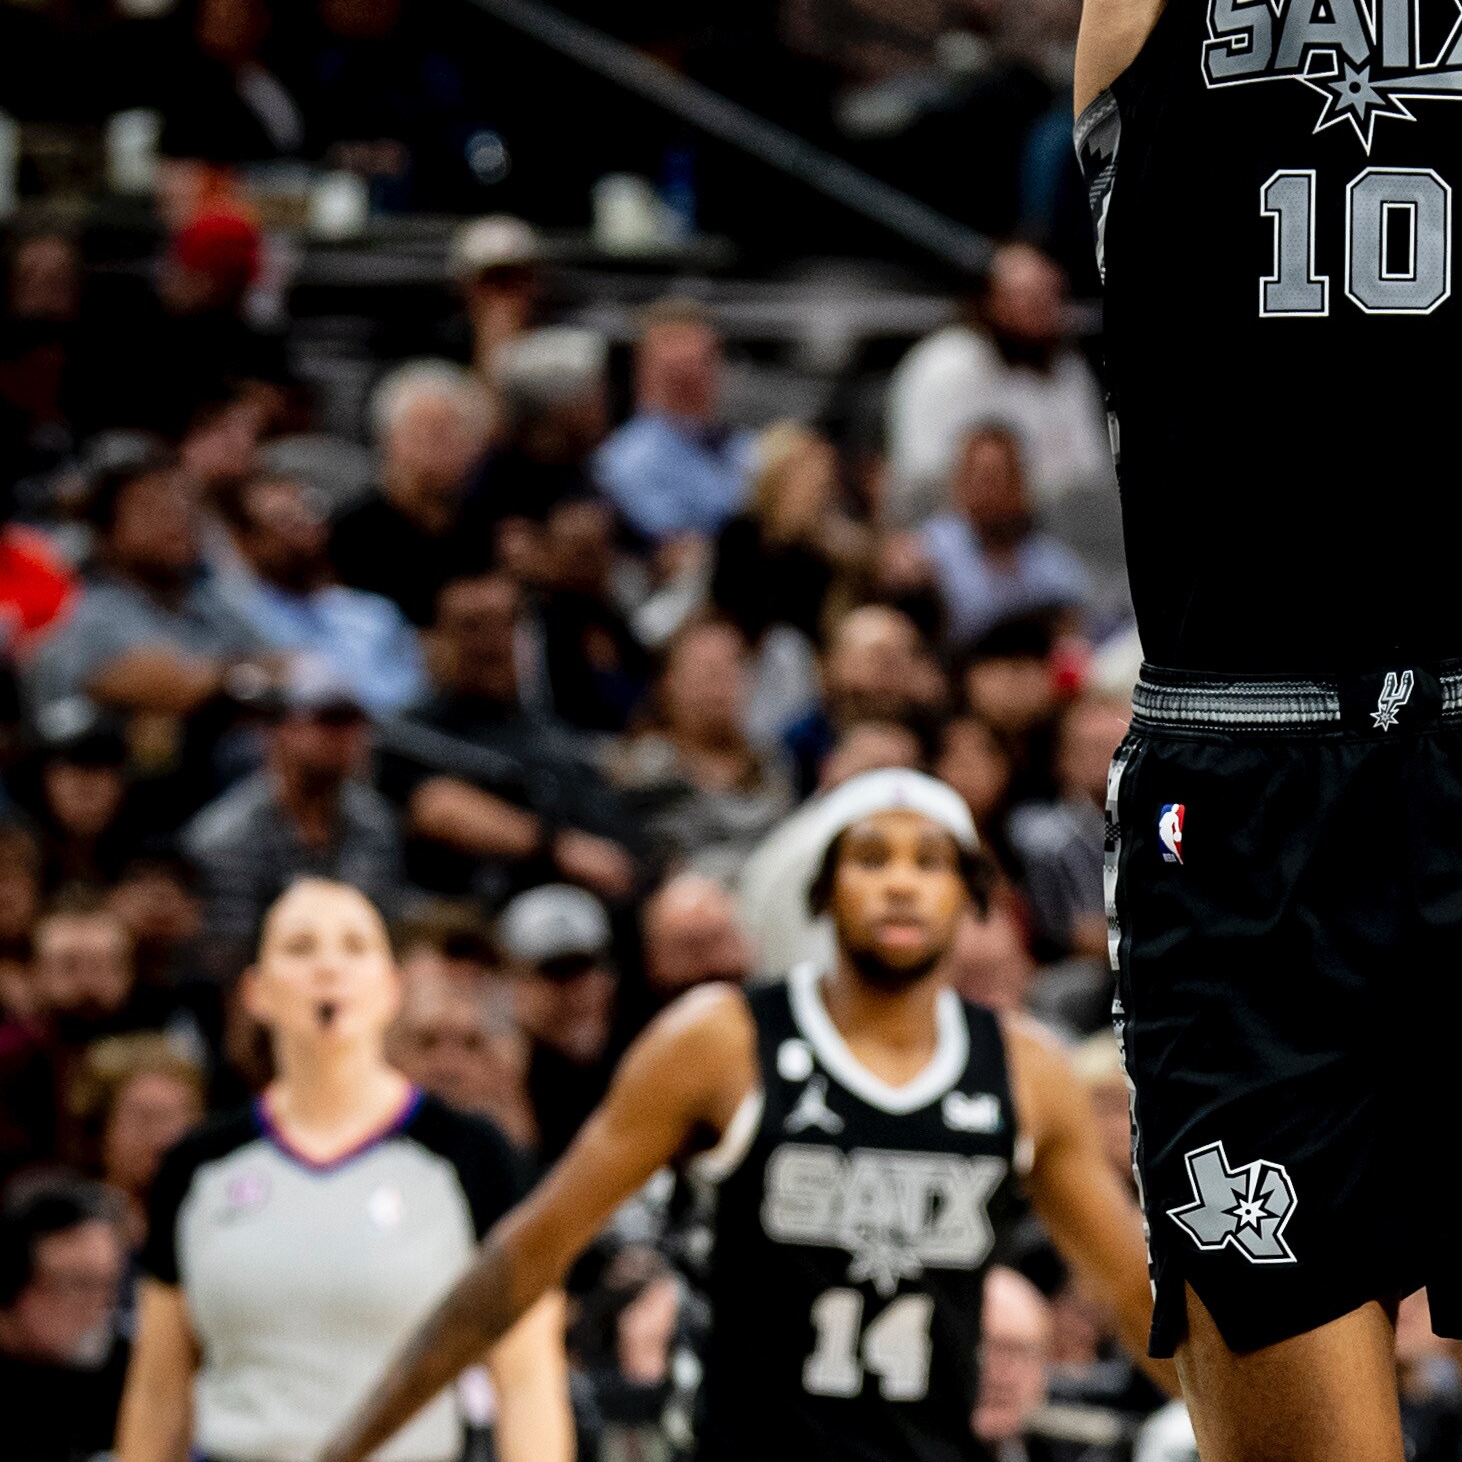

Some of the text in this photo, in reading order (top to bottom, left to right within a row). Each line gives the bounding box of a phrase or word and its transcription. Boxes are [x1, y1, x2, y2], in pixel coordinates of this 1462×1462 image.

[1258, 166, 1452, 318] 10
[760, 1141, 1008, 1272] SATX
[801, 1285, 937, 1403] 14
